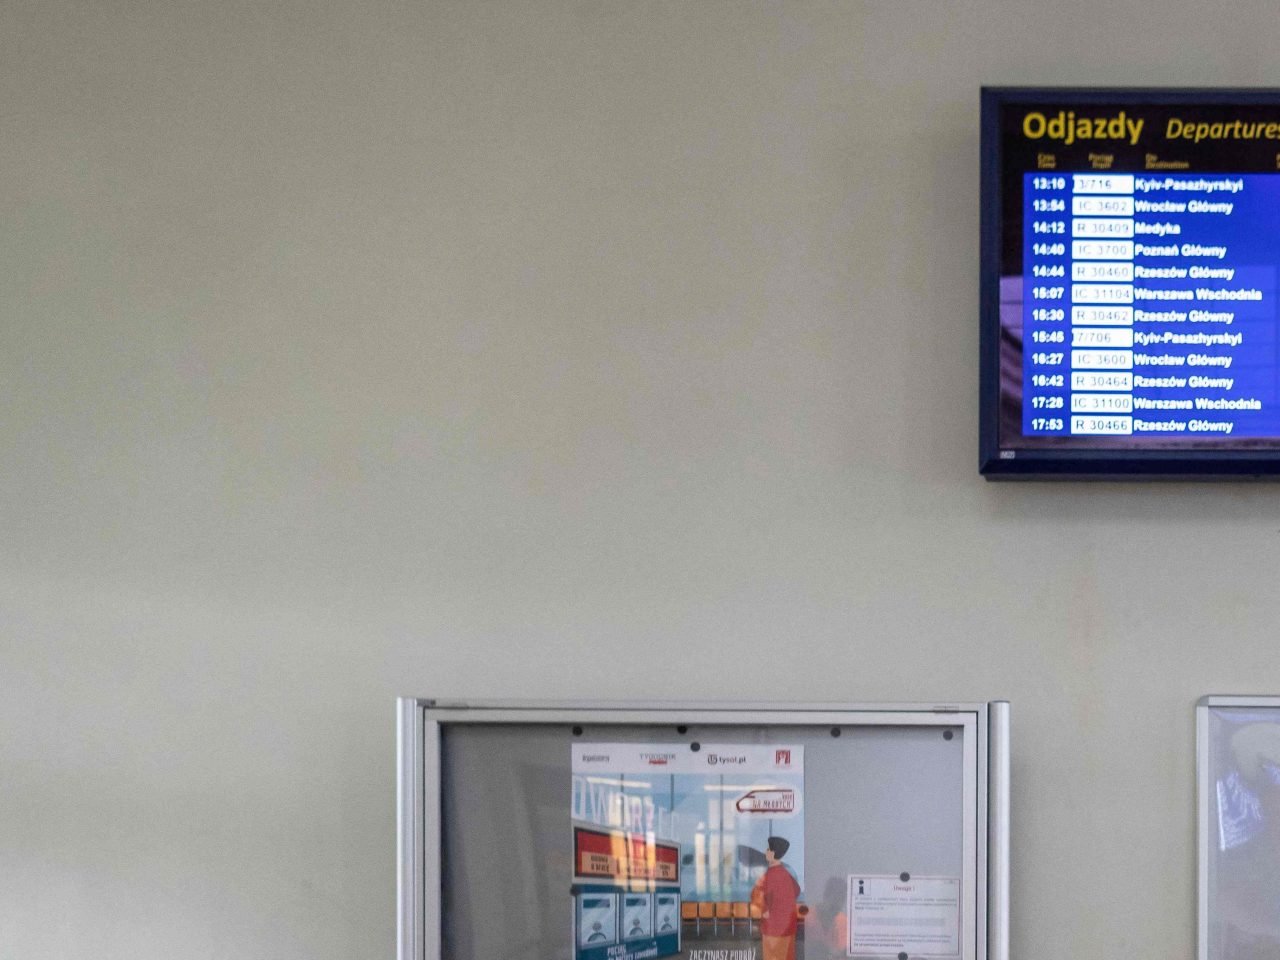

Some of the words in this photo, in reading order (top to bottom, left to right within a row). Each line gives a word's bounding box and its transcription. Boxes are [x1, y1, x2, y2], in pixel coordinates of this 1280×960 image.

[1022, 112, 1144, 145] Odjazdy
[1034, 221, 1065, 234] 14:12
[1091, 223, 1130, 233] 30409
[1134, 221, 1181, 237] Medyka
[1134, 243, 1180, 257] Poznań
[1033, 265, 1065, 277] 14:44
[1091, 268, 1130, 278] 30460
[1134, 265, 1186, 280] Rzeszów
[1092, 288, 1131, 299] 31104
[1134, 288, 1194, 301] Warszawa
[1196, 287, 1263, 301] Wschodnia
[1090, 310, 1128, 321] 30462
[1134, 309, 1186, 323] Rzeszów
[1096, 354, 1127, 365] 3600
[1076, 376, 1086, 387] R
[1090, 376, 1128, 387] 30464
[1134, 375, 1187, 388] Rzeszów
[1032, 396, 1064, 409] 17:28
[1074, 398, 1087, 408] IC
[1092, 398, 1130, 409] 31100
[1133, 397, 1193, 410] Warszawa
[1195, 397, 1262, 410] Wschodnia
[1031, 418, 1063, 431] 17:53
[1076, 420, 1085, 431] R
[1090, 420, 1128, 431] 30466
[1133, 419, 1187, 432] Rzeszów
